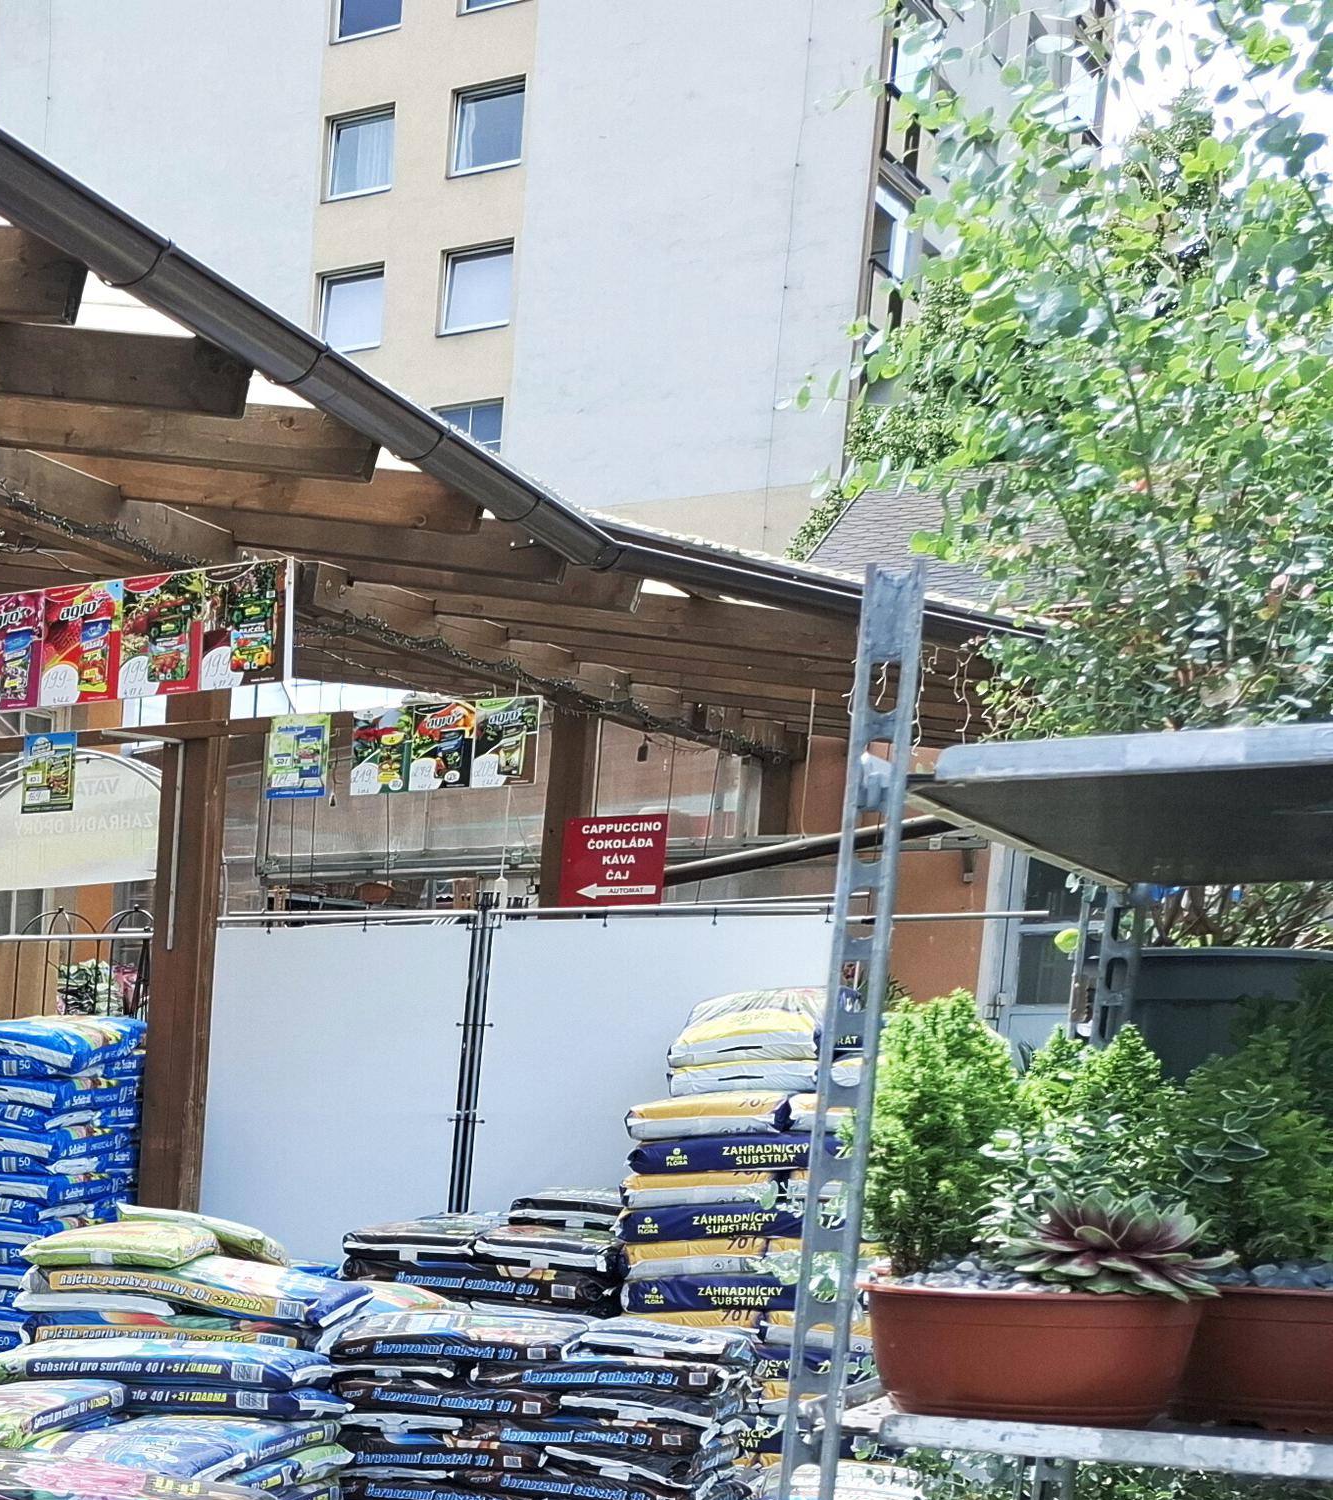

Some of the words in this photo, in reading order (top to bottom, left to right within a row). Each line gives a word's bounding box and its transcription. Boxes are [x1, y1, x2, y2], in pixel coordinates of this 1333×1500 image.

[60, 601, 98, 621] agro
[582, 821, 662, 835] CAPPUCCINO
[587, 836, 653, 849] ČOKOLÁDA
[602, 852, 635, 865] KÁVA
[605, 868, 629, 880] ČAJ
[607, 886, 644, 895] AUTOMAT
[22, 1108, 33, 1117] 50
[736, 1153, 795, 1165] SUBSTRÁT
[692, 1211, 778, 1225] ZÁHRADNÍCKY
[705, 1222, 764, 1234] SUBSTRÁT
[34, 1360, 80, 1372] Substrát
[81, 1360, 99, 1372] pro
[145, 1362, 158, 1373] 40
